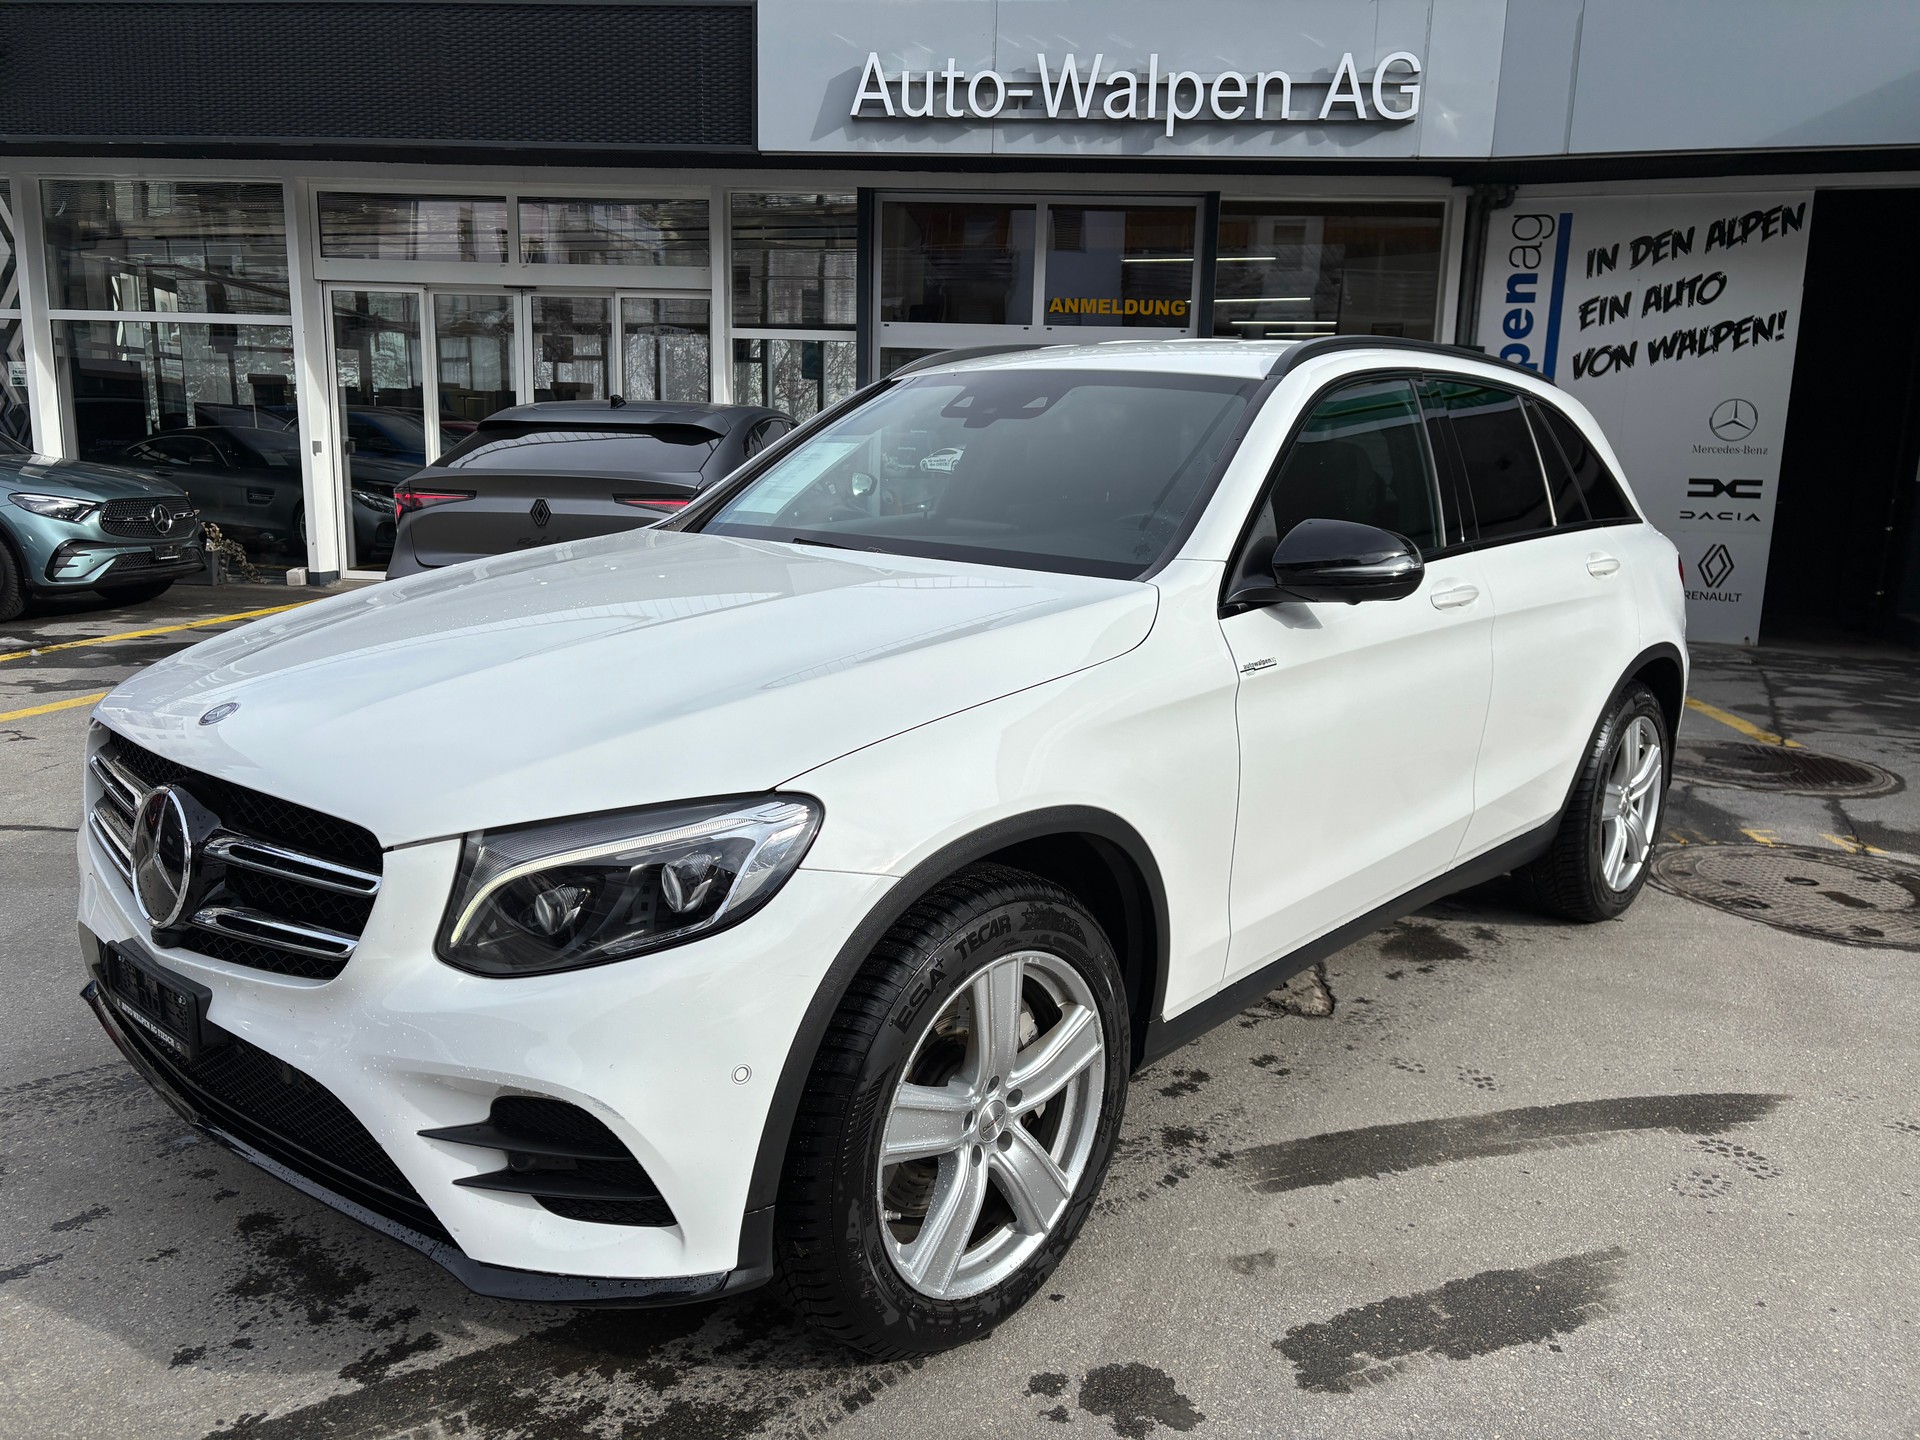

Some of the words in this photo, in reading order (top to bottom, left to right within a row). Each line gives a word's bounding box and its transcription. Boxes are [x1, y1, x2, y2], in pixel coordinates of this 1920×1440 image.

[850, 51, 1292, 137] Auto-Walpen
[1318, 51, 1421, 120] AG
[1586, 243, 1619, 279] IN
[1629, 226, 1695, 270] DEN
[1704, 202, 1806, 254] ALPEN
[1049, 296, 1186, 317] ANMELDUNG
[1578, 291, 1632, 331] EIN
[1641, 271, 1727, 319] AUTO
[1572, 340, 1638, 380] VON
[1648, 310, 1787, 367] WALPEN!
[1692, 444, 1768, 456] Mercedes-Benz
[1680, 511, 1760, 521] DACIA
[1684, 590, 1742, 603] RENAULT
[952, 914, 1012, 961] TECAR
